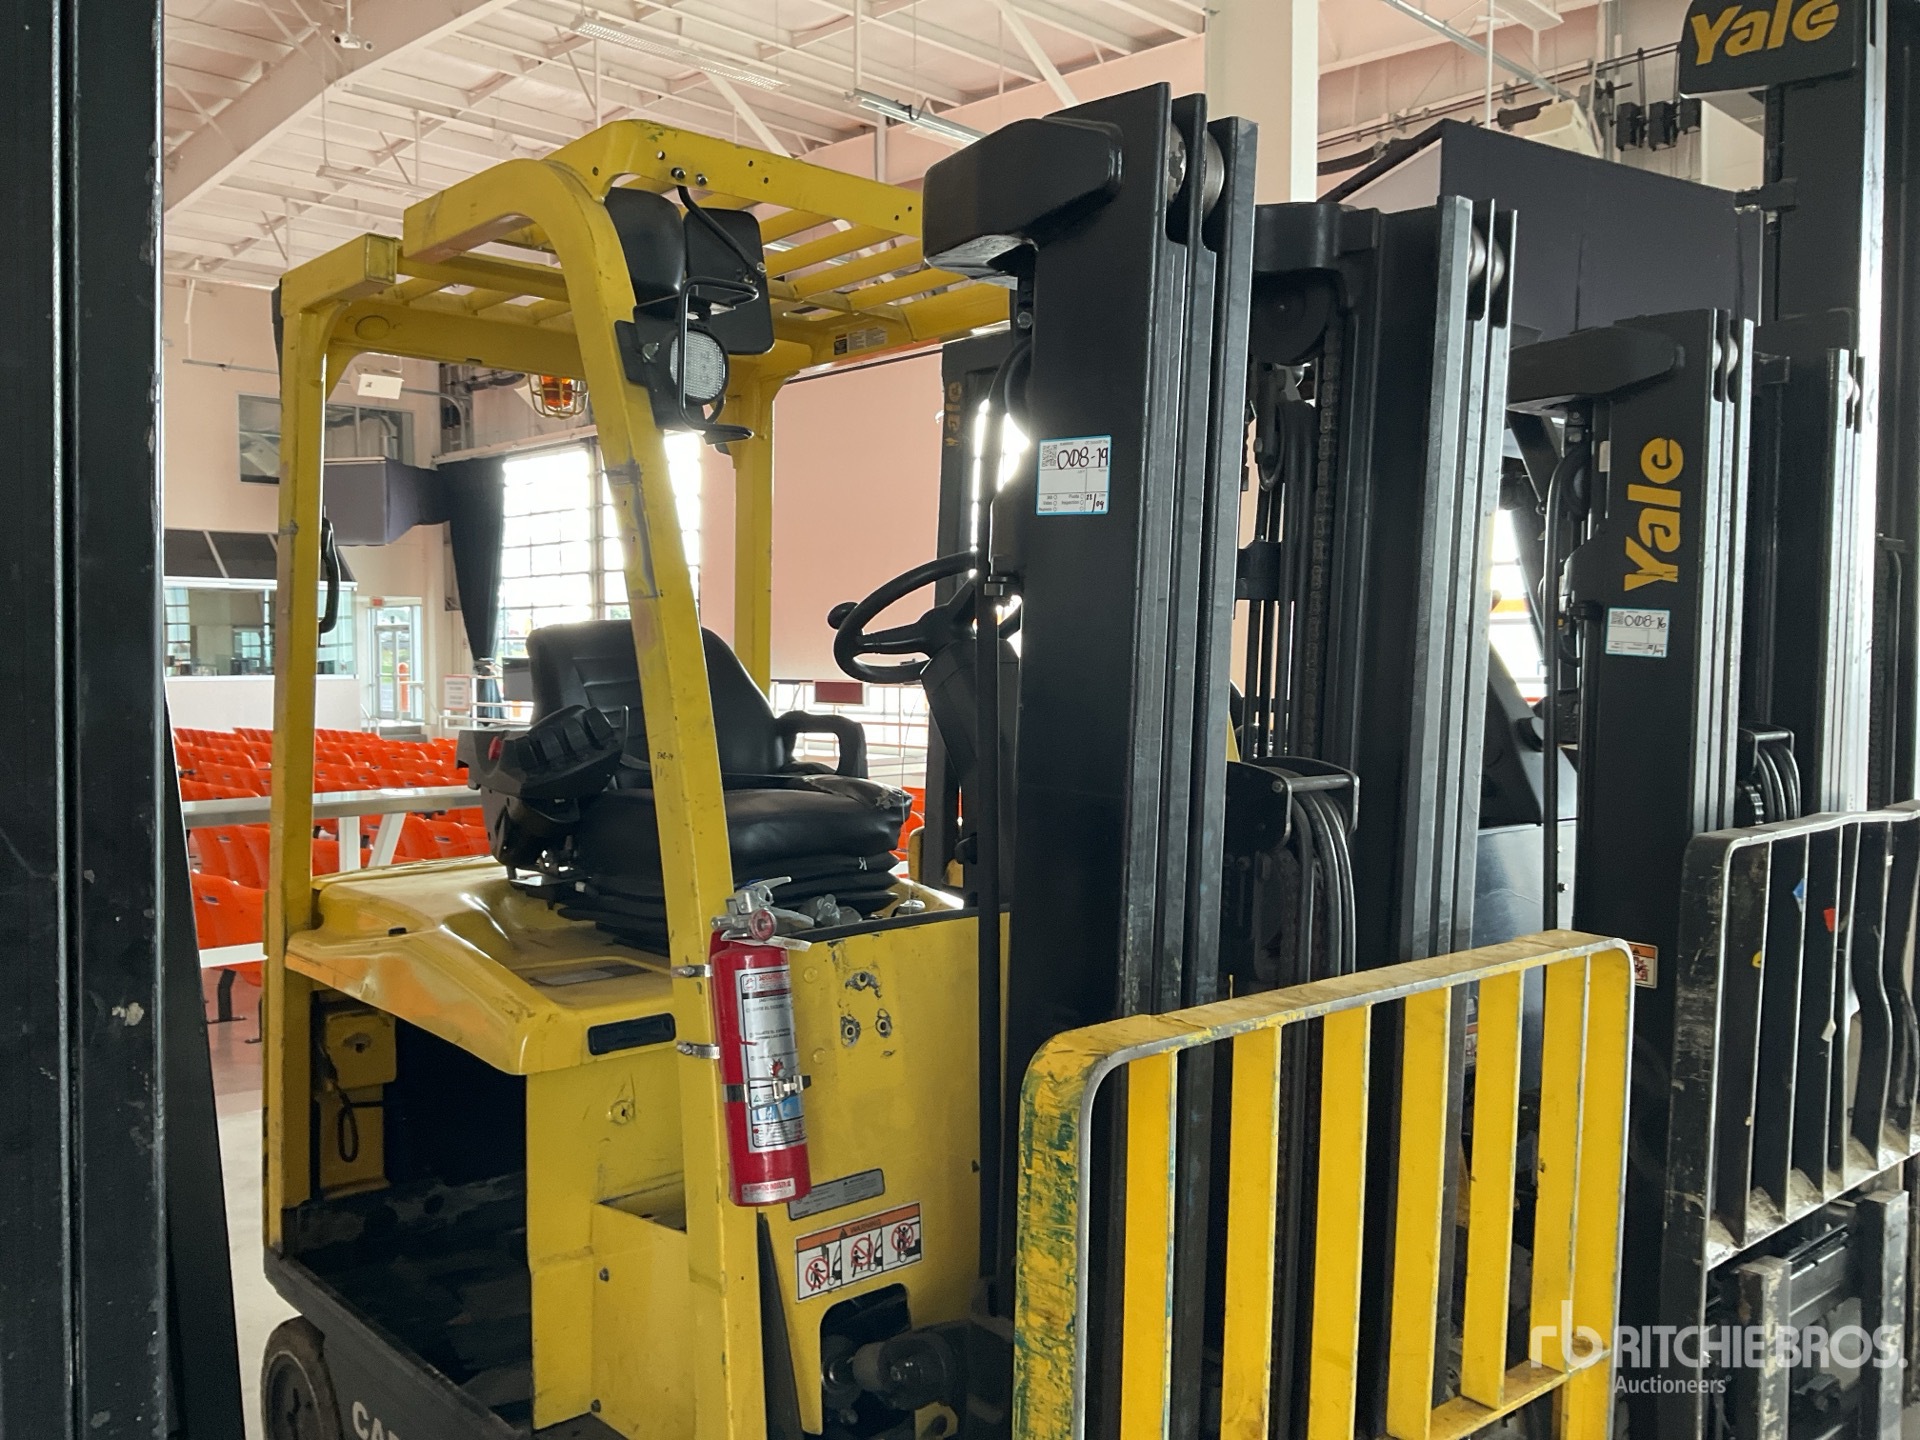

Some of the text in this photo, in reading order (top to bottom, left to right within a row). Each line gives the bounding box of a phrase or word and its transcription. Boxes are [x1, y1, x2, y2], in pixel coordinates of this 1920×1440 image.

[1691, 0, 1840, 66] Yale
[1624, 437, 1684, 592] Yale
[352, 1401, 400, 1440] CA
